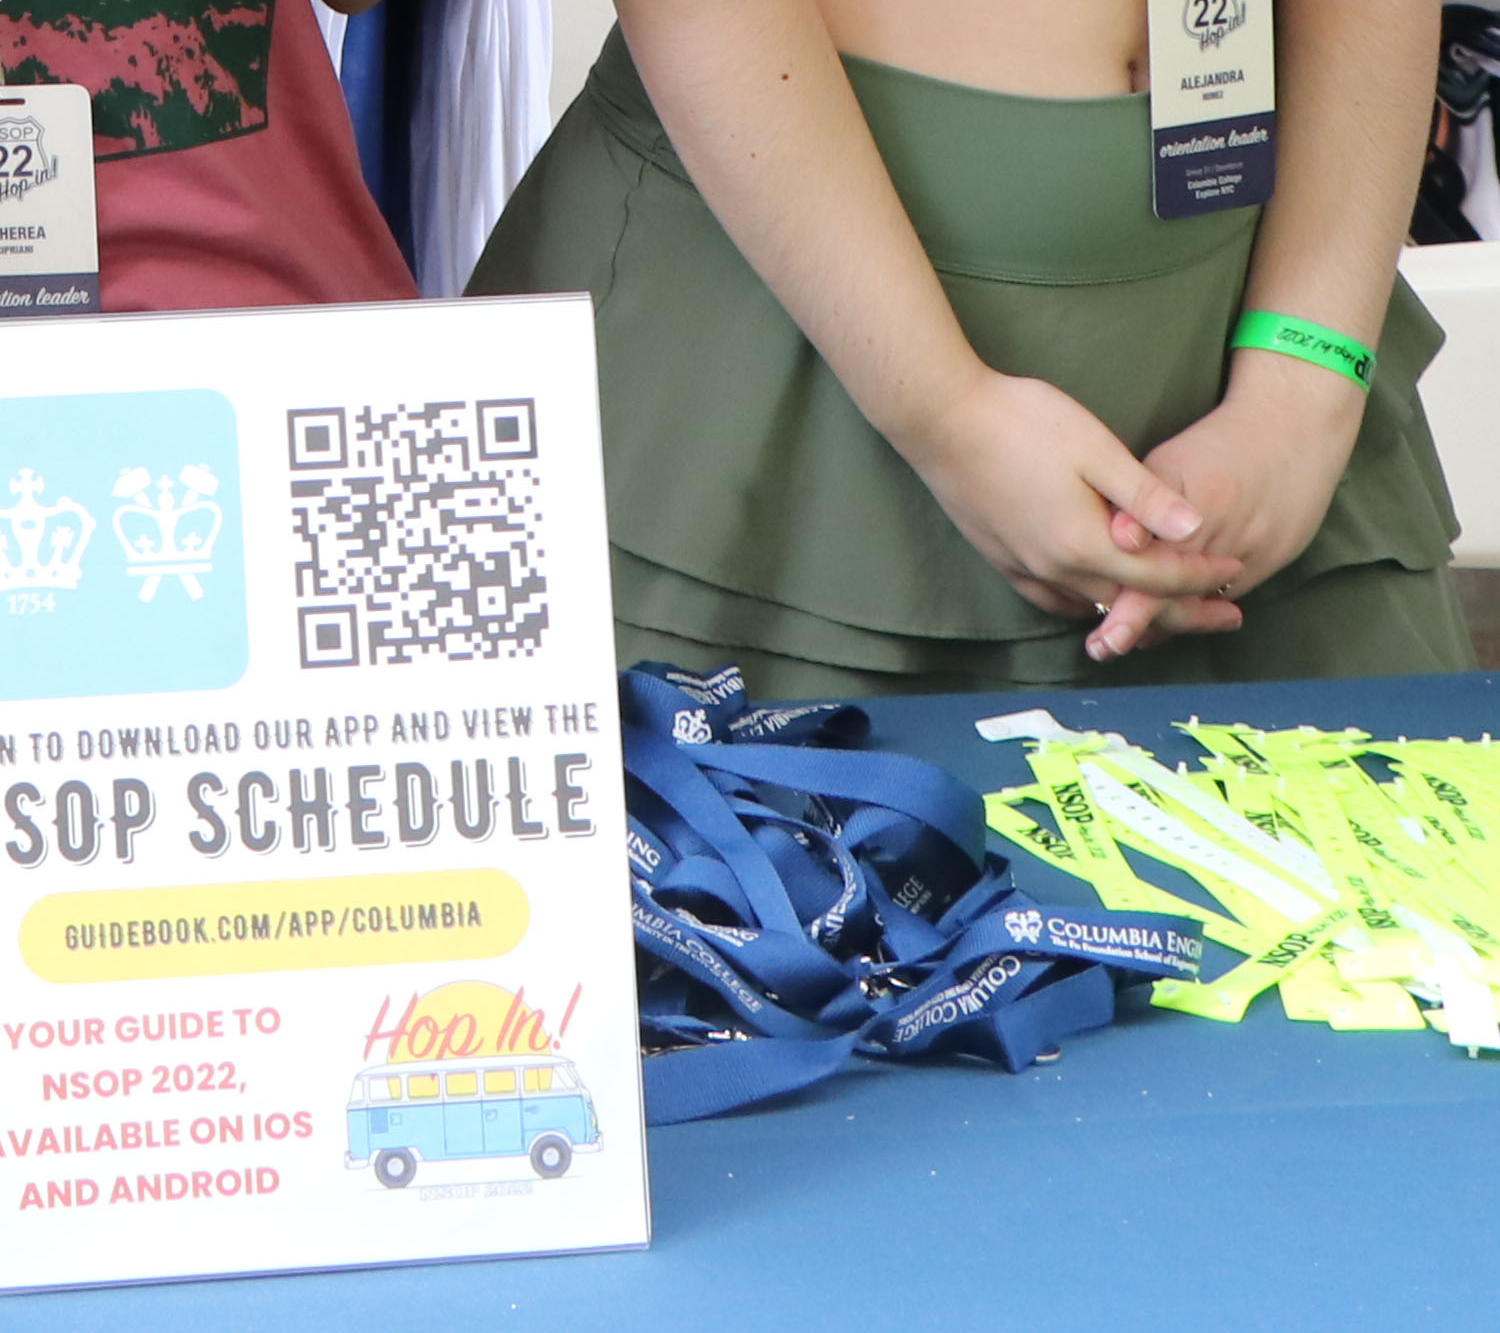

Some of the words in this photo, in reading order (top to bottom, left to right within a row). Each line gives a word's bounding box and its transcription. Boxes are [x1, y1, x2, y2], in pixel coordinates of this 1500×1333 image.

[1199, 26, 1225, 52] Hop
[1180, 69, 1245, 91] ALEJANDRA
[1159, 136, 1226, 159] orientation
[1228, 128, 1269, 148] leader
[35, 285, 90, 307] leader
[6, 592, 57, 616] 1754
[28, 731, 64, 763] TO
[77, 721, 241, 761] DOWNLOAD
[254, 718, 314, 750] OUR
[325, 714, 379, 746] APP
[391, 710, 450, 744] AND
[462, 706, 533, 739] VIEW
[544, 702, 600, 735] THE
[187, 752, 597, 859] SCHEDULE
[1050, 776, 1095, 830] NSOP
[64, 900, 483, 952] GUIDEBOOK.COM/APP/COLUMBIA
[1046, 917, 1163, 951] COLUMBIA
[1255, 924, 1315, 979] NSOP
[676, 935, 770, 1013] COLLEGE
[2, 1017, 106, 1050] YOUR
[114, 1010, 225, 1043] GUIDE
[232, 1006, 282, 1036] TO
[363, 991, 485, 1063] Hop
[496, 982, 583, 1053] In!
[41, 1068, 143, 1102] NSOP
[151, 1061, 247, 1094] 2022,
[189, 1114, 244, 1144] ON
[253, 1110, 314, 1141] IOS
[19, 1178, 100, 1211] AND
[108, 1166, 280, 1204] ANDROID
